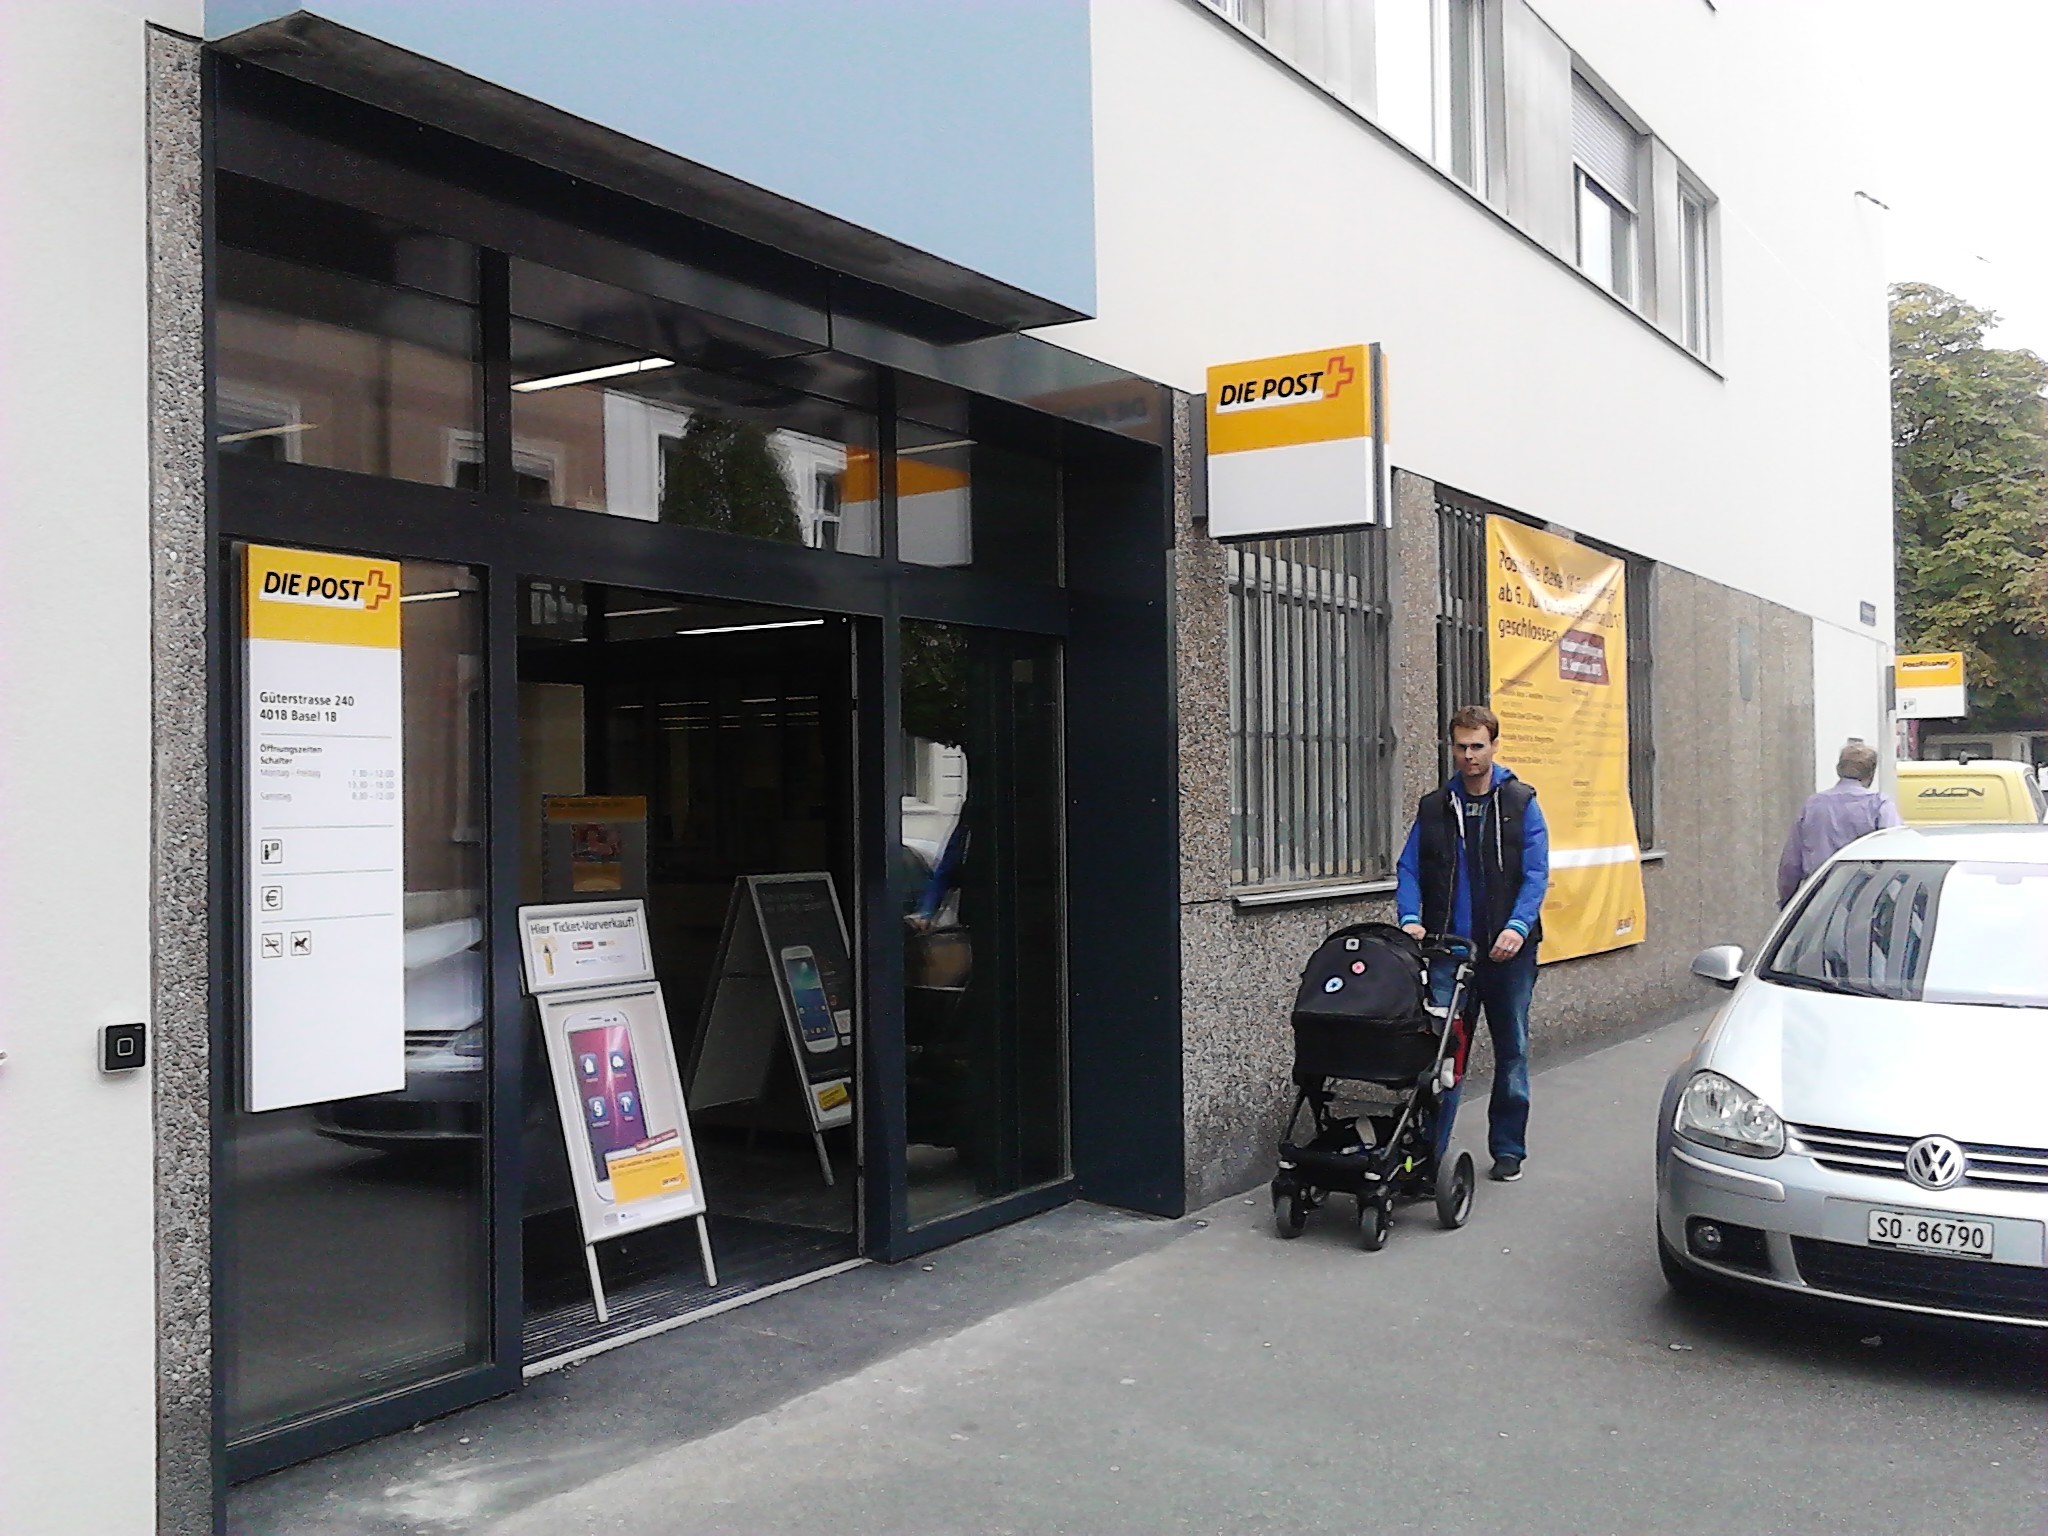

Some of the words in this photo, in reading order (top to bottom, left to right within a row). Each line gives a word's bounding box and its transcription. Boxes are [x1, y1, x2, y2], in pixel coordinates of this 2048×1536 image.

[1220, 381, 1257, 406] DIE
[1262, 371, 1324, 399] POST
[264, 571, 302, 595] DIE
[306, 576, 365, 602] POST
[1498, 582, 1513, 602] ab
[1498, 617, 1560, 643] geschlossen
[260, 691, 332, 706] Güterstrasse
[335, 695, 355, 707] 240
[260, 709, 288, 720] 4018
[291, 710, 320, 722] Basel
[325, 711, 337, 722] 18
[530, 924, 550, 935] Hier
[553, 916, 635, 933] Ticket-Vorverkauf!
[1877, 1217, 1902, 1239] SO
[1917, 1221, 1984, 1249] 86790
